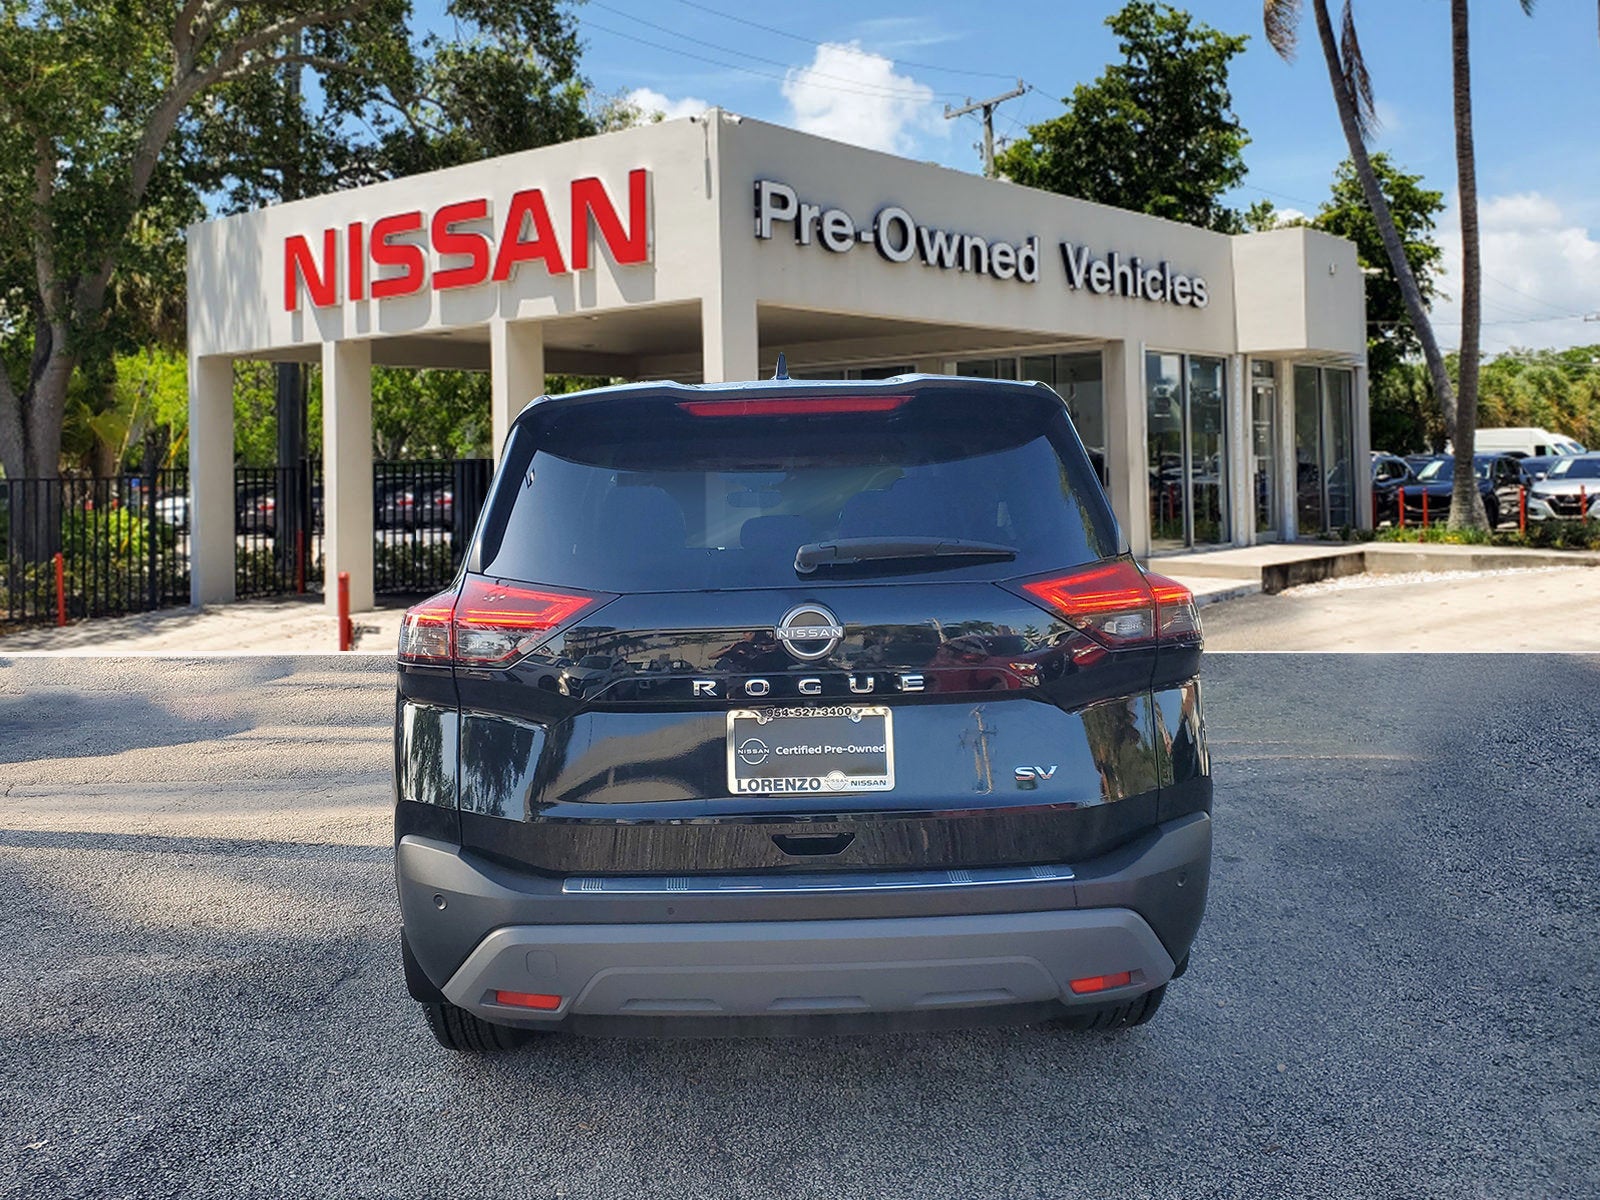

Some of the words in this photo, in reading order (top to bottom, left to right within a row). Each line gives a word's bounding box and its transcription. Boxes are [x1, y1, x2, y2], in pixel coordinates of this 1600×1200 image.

[284, 168, 648, 312] NISSAN
[754, 180, 1040, 284] Pre-Owned
[1060, 241, 1209, 309] Vehicles
[777, 626, 844, 640] NISSAN
[692, 674, 925, 697] ROGUE
[775, 745, 822, 756] Certified
[824, 743, 886, 754] Pre-Owned
[1014, 765, 1058, 780] SV
[737, 778, 822, 792] LORENZO
[850, 779, 887, 787] NISSAN
